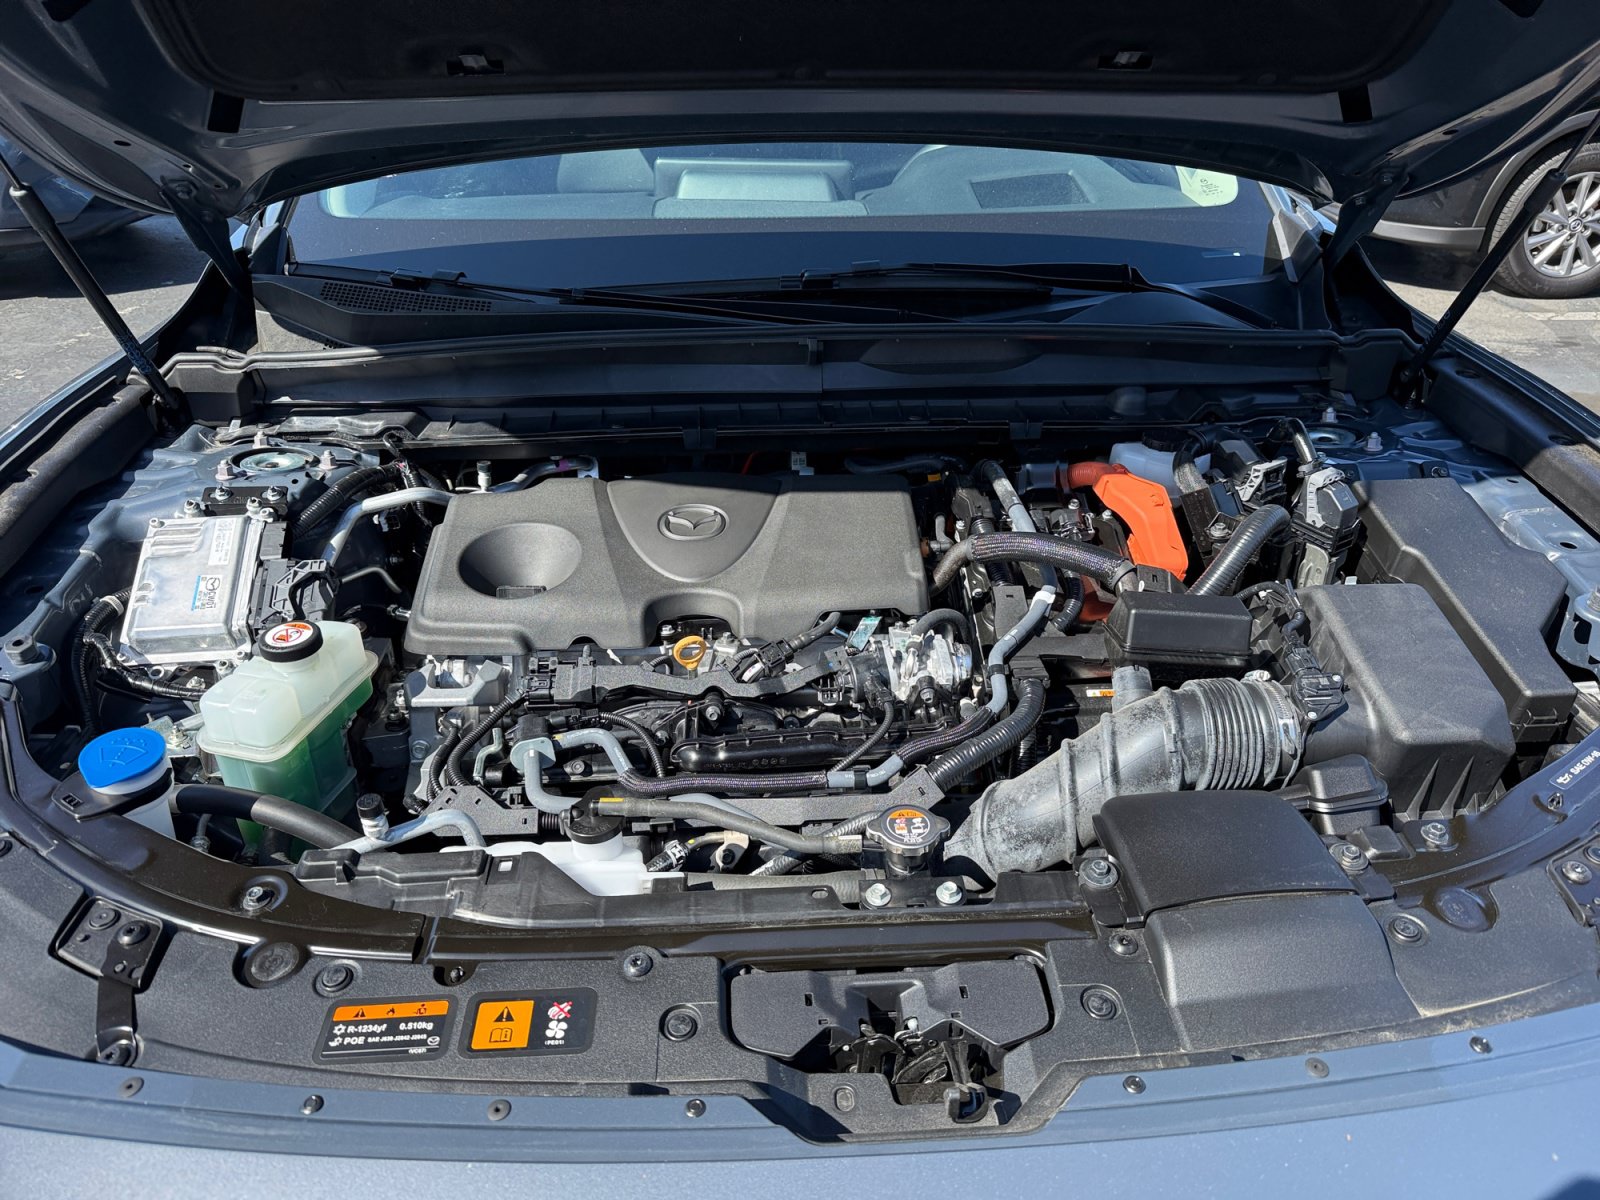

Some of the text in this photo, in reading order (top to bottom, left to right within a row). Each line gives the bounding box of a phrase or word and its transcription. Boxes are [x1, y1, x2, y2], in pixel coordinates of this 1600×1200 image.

[1570, 762, 1586, 774] SAE
[347, 1021, 434, 1034] R-1234yf 0.510kg
[343, 1036, 365, 1046] POE
